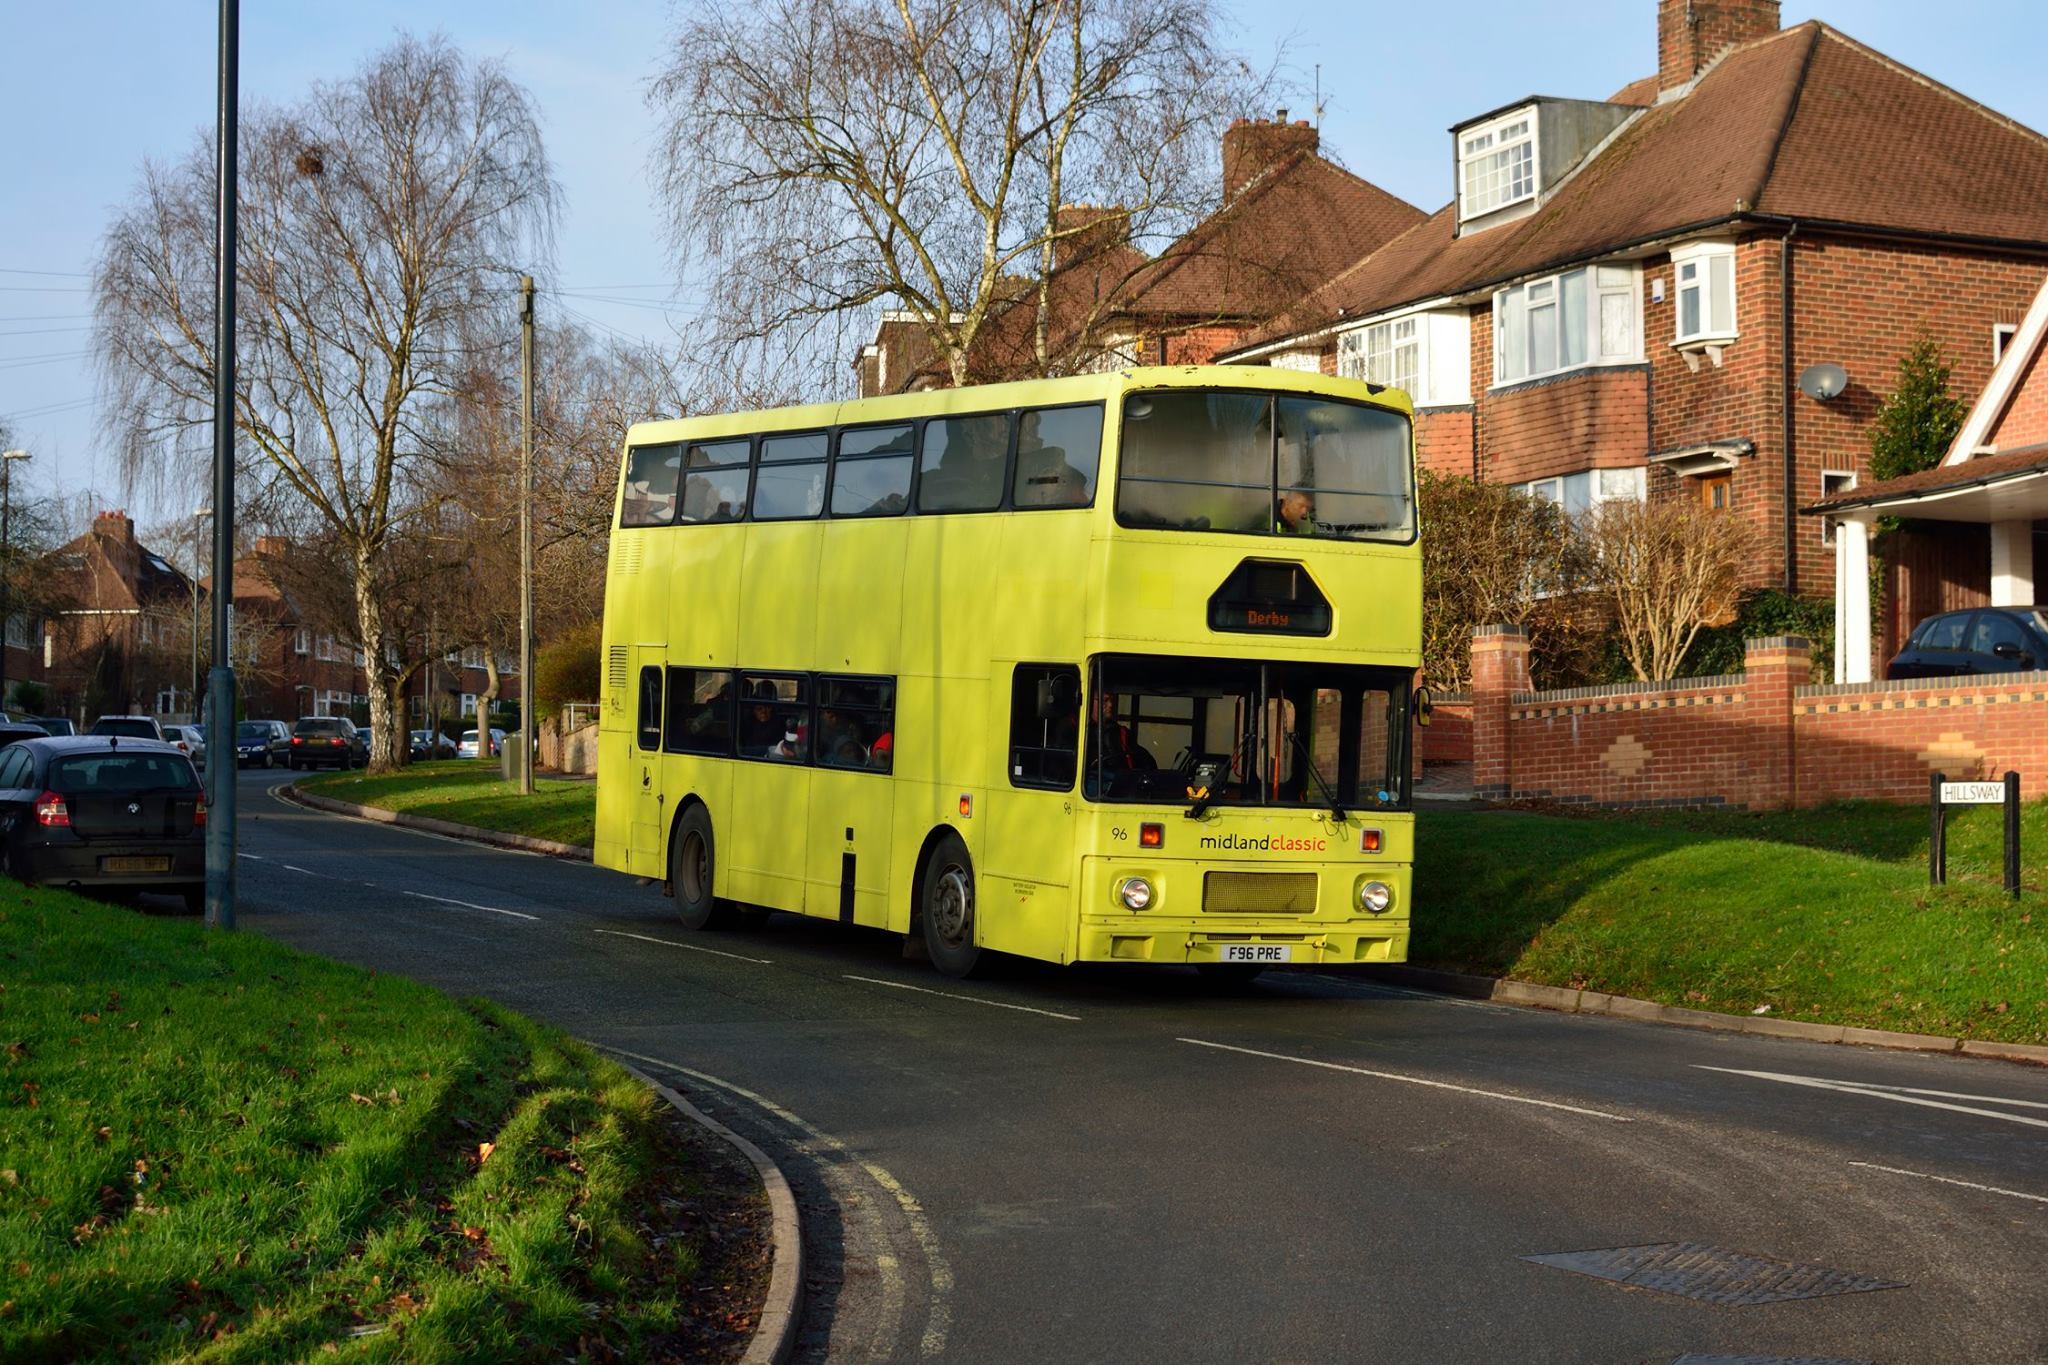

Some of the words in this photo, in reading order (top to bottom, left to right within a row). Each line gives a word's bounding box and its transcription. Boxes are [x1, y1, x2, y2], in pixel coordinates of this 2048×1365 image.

[1247, 610, 1289, 626] Derby
[1944, 784, 2002, 801] HILLSWAY
[1063, 801, 1072, 815] 96
[1111, 827, 1127, 841] 96
[1229, 946, 1254, 960] F96
[1257, 946, 1283, 960] PRE
